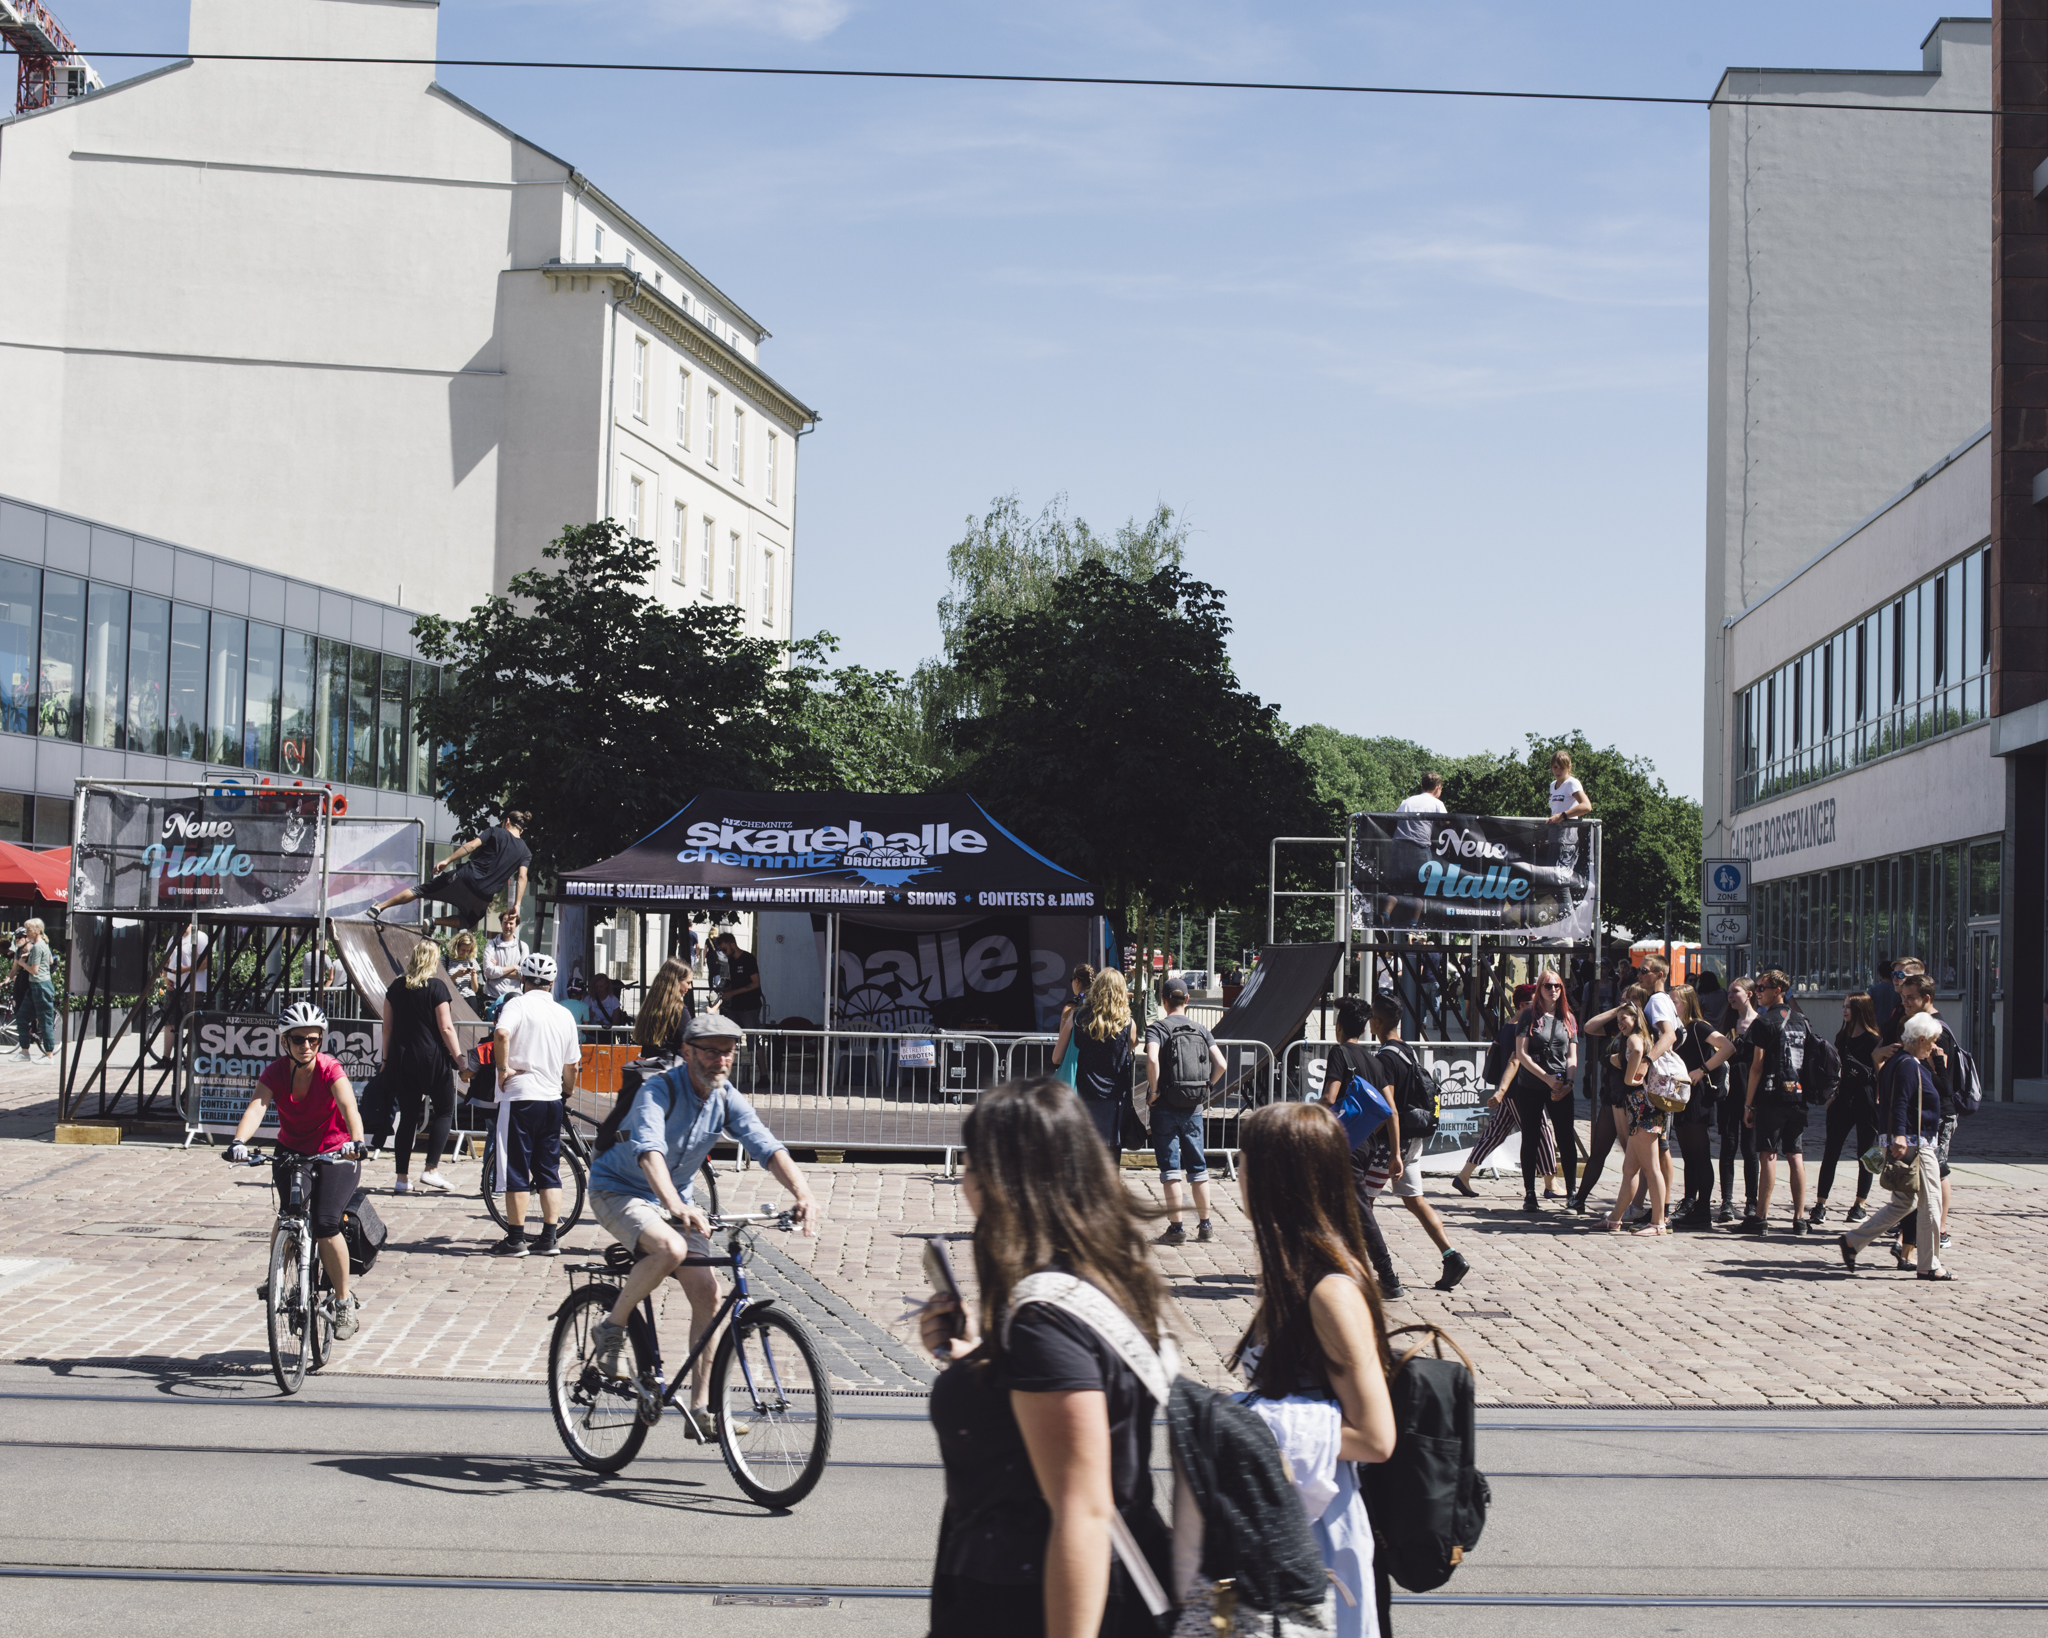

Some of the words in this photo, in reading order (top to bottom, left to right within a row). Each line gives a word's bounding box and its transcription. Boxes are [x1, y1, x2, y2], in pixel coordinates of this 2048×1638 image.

[162, 811, 235, 839] Neue
[1731, 822, 1763, 862] GALERIE
[1764, 798, 1836, 859] BORSSENANGER
[685, 820, 988, 854] skatehalle
[1435, 828, 1509, 859] Neue
[142, 843, 255, 878] Halle
[677, 846, 837, 868] chemnitz
[843, 855, 928, 867] DRUCKBUDE
[1418, 860, 1531, 900] Halle
[177, 887, 213, 895] DRUCKBUDE
[565, 882, 614, 897] MOBILE
[616, 883, 710, 900] SKATERAMPEN
[731, 887, 886, 905] WWW.RENTTHERAMP.DE
[907, 891, 957, 906] SHOWS
[978, 891, 1045, 906] CONTESTS
[1047, 894, 1058, 906] &
[1060, 892, 1095, 906] JAMS
[1717, 893, 1738, 901] ZONE
[1456, 908, 1491, 916] DRUCKBUDE
[1492, 909, 1501, 917] 2.0
[1721, 933, 1736, 942] frei
[901, 1052, 934, 1060] VERBOTEN
[201, 1099, 232, 1109] CONTEST
[233, 1101, 239, 1109] &
[200, 1111, 228, 1120] VERLEIH
